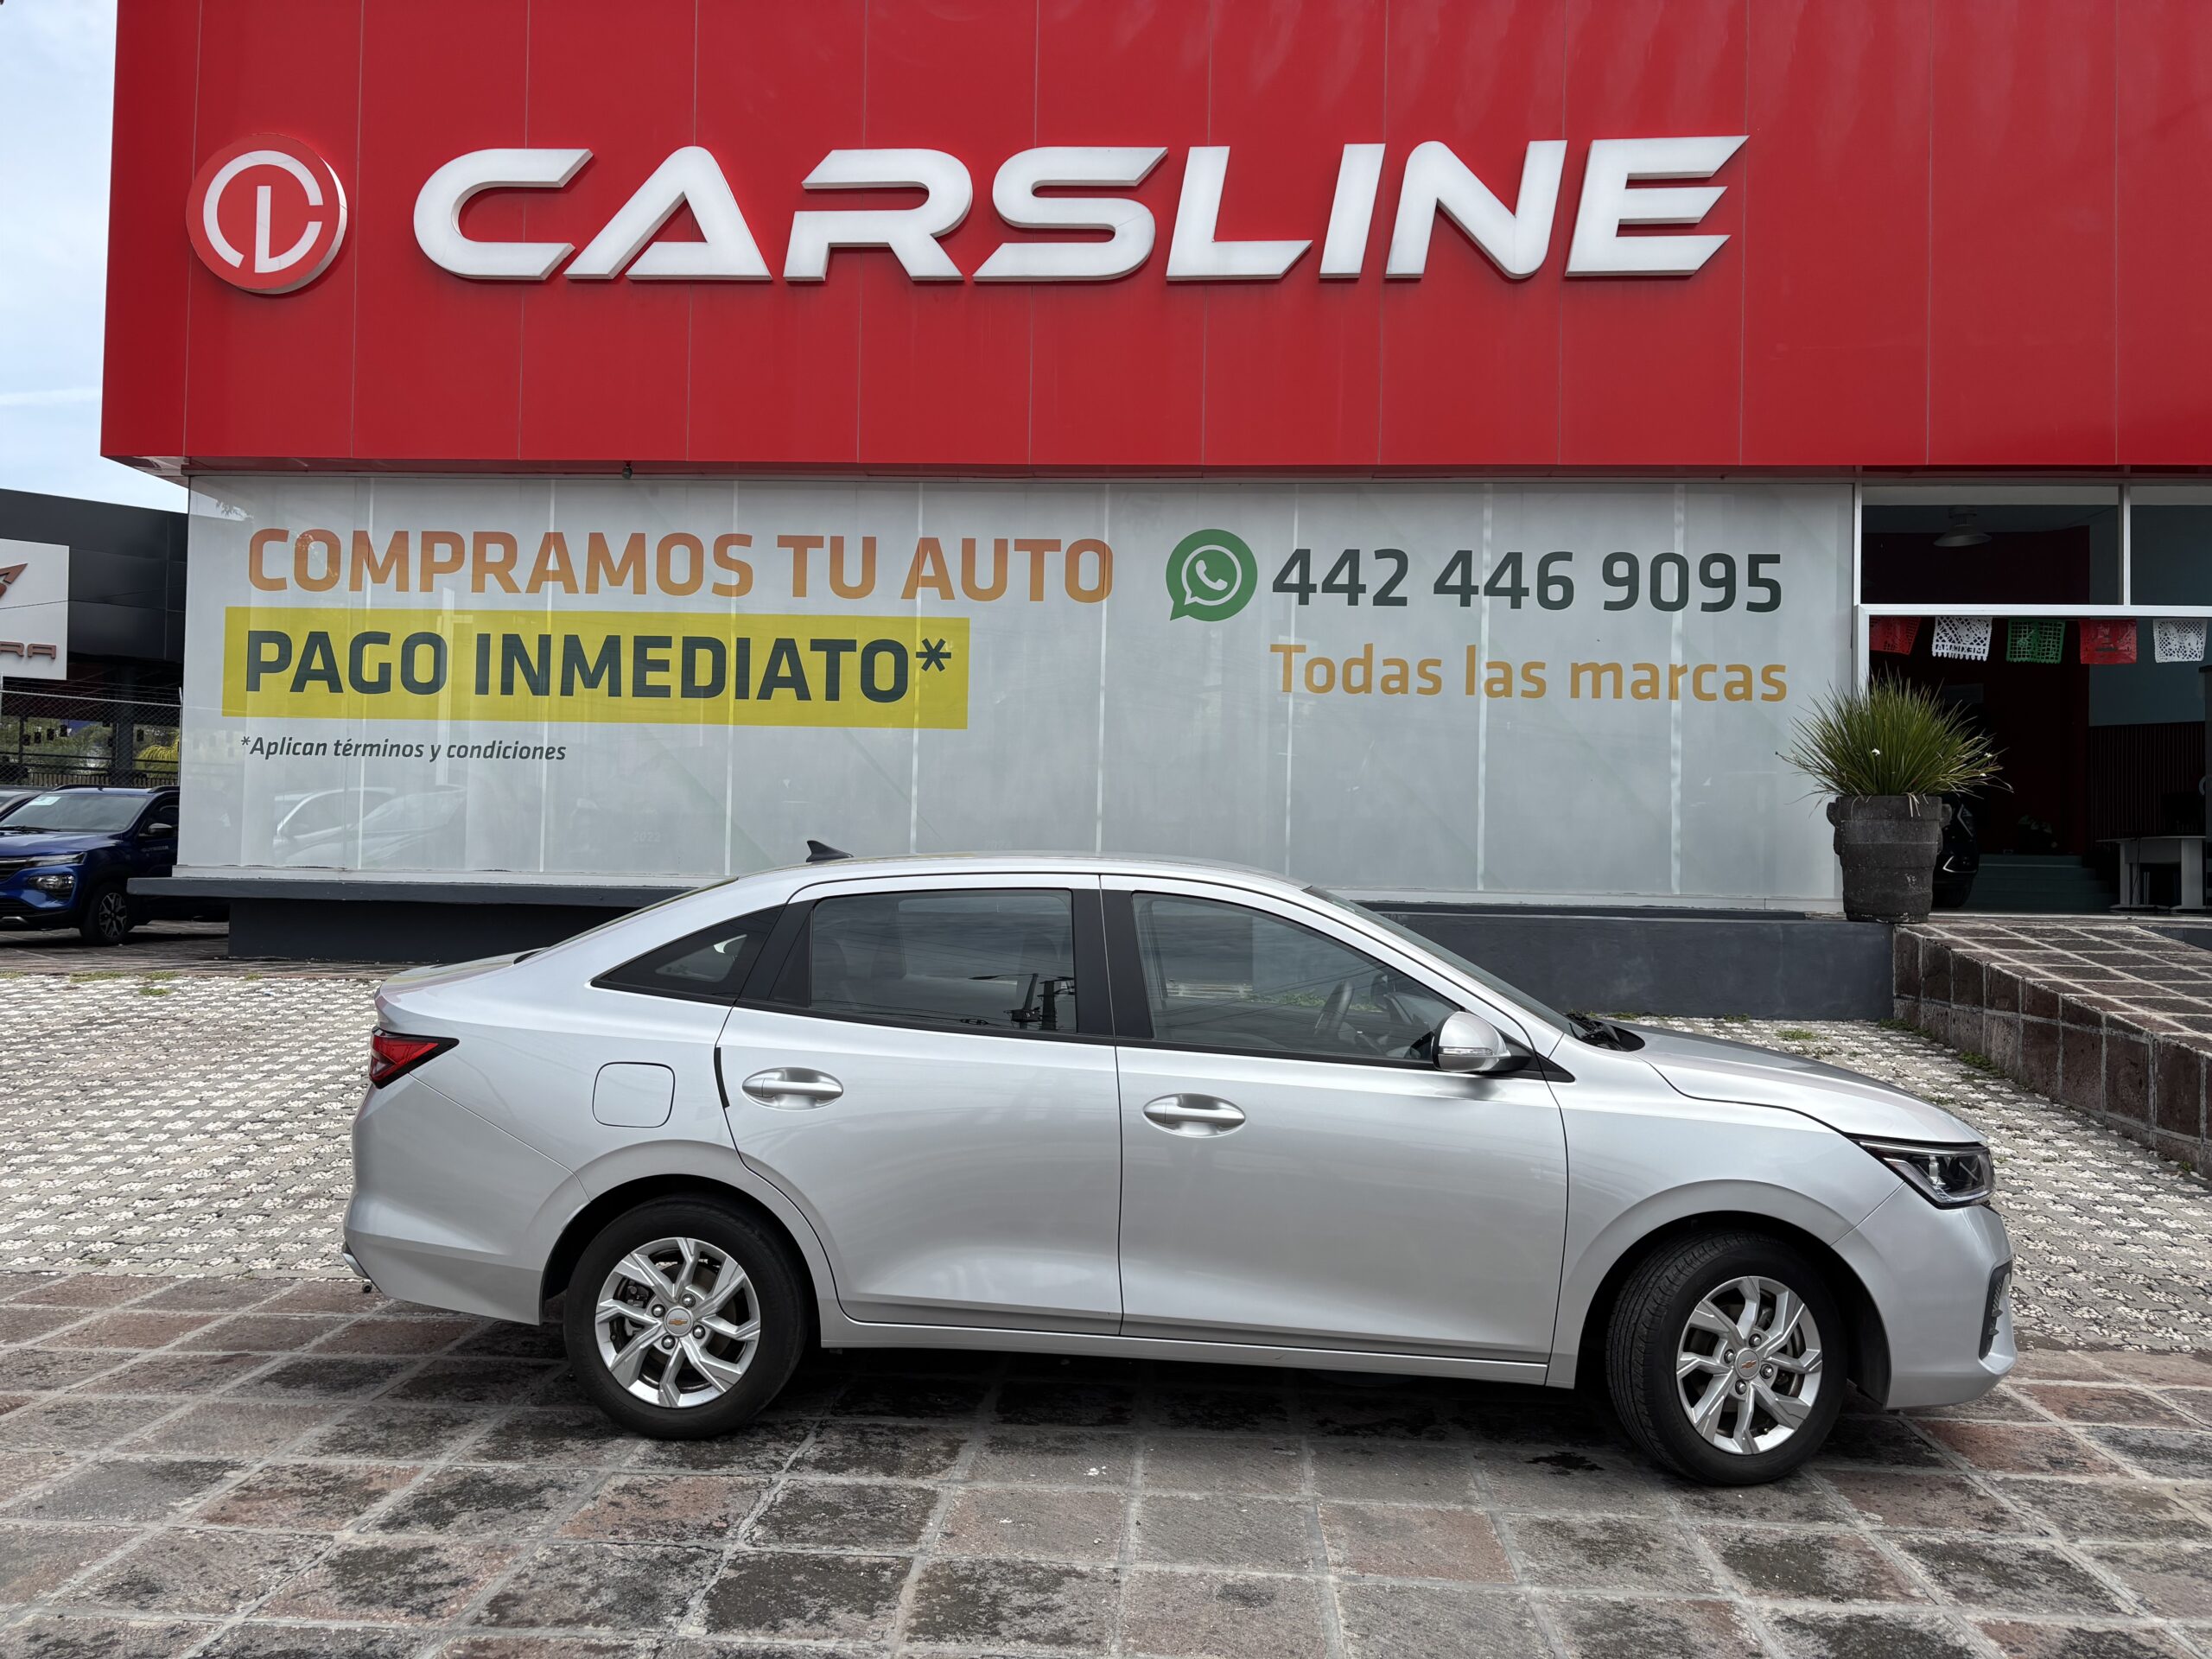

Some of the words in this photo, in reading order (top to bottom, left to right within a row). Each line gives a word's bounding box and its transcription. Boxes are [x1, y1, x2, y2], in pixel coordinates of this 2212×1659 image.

[412, 134, 1751, 283] CARSLINE
[248, 528, 753, 598] COMPRAMOS
[777, 535, 877, 600] TU
[900, 537, 1114, 603] AUTO
[1272, 548, 1408, 607] 442
[1433, 550, 1574, 611] 446
[1602, 551, 1783, 613] 9095
[245, 630, 448, 696] PAGO
[1269, 643, 1443, 696] Todas
[1465, 644, 1548, 699] las
[1569, 661, 1788, 702] marcas
[333, 739, 424, 758] términos
[429, 744, 442, 762] y
[446, 741, 567, 761] condiciones
